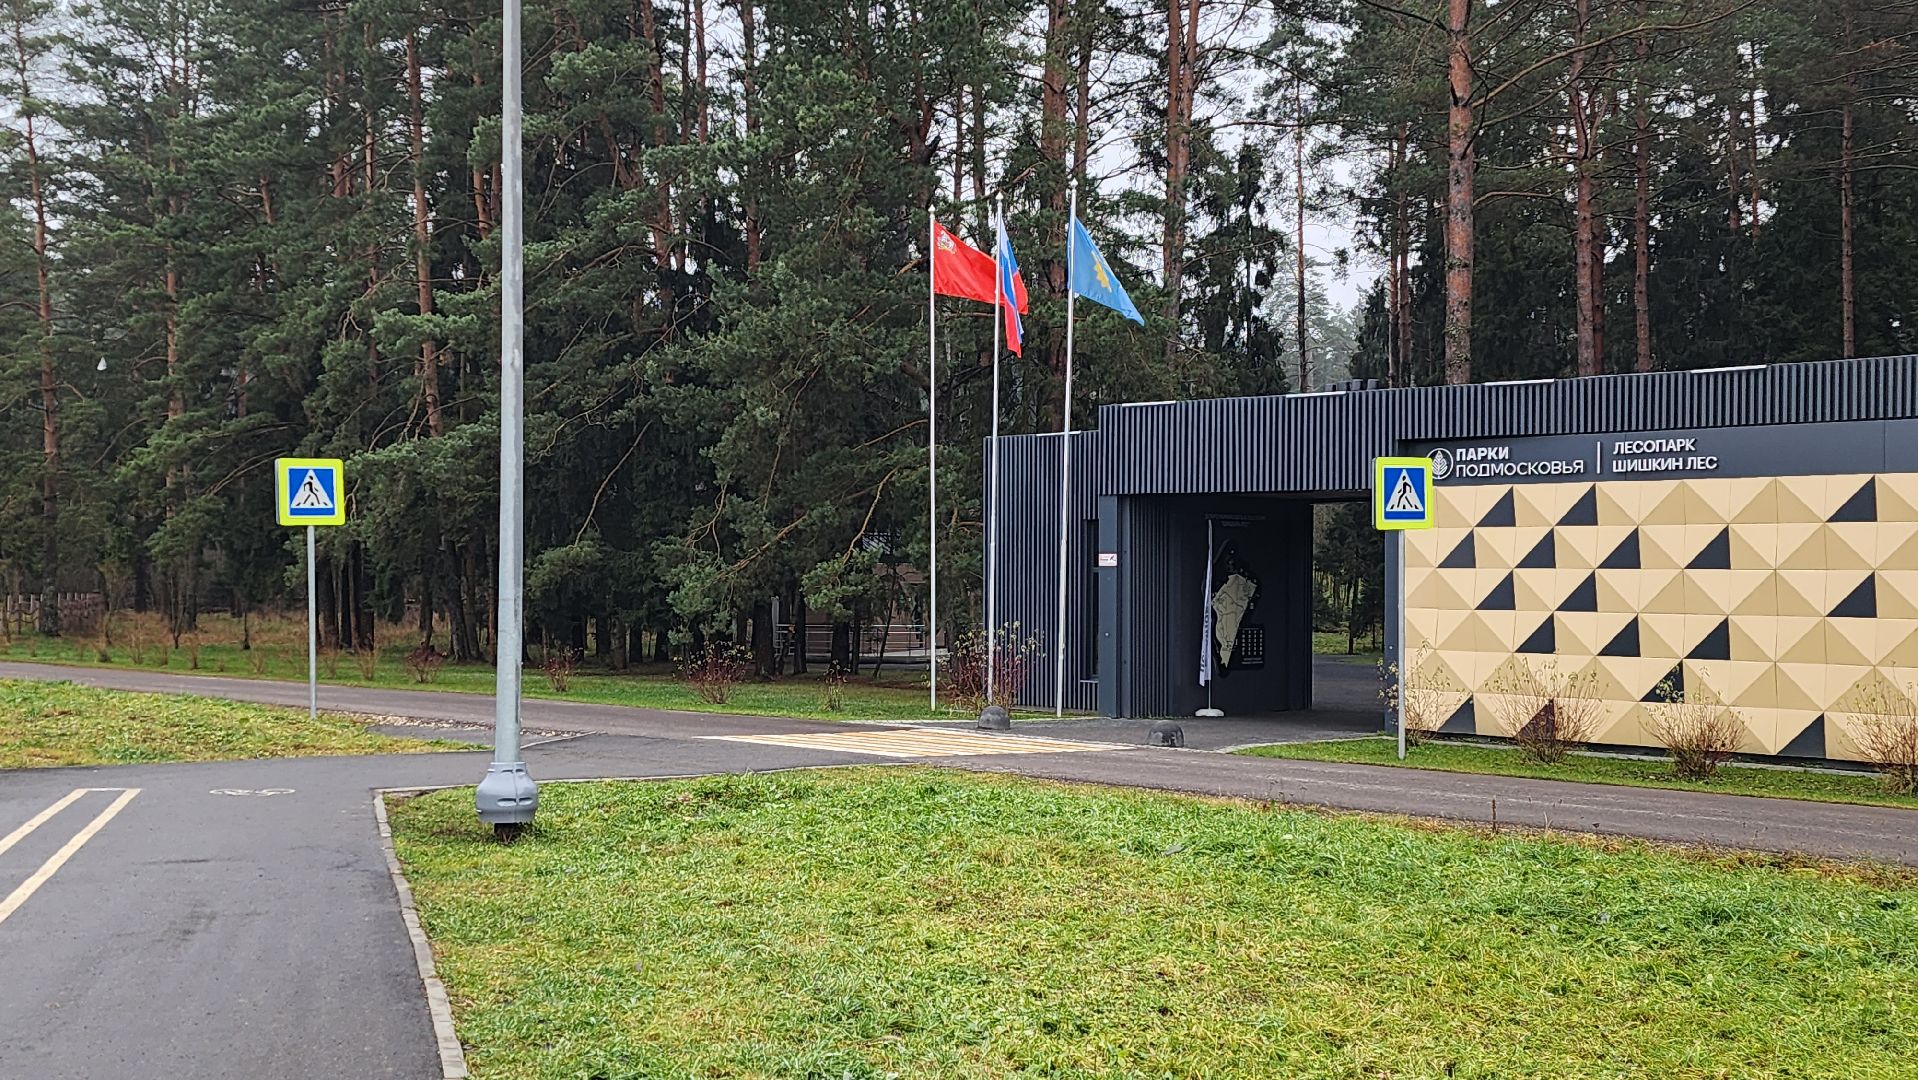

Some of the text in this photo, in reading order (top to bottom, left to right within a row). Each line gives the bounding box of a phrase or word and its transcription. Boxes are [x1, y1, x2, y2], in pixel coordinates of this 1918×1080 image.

[1456, 446, 1509, 462] ПАРКИ
[1612, 438, 1697, 455] ЛЕСОПАРК
[1456, 460, 1585, 478] ПОДМОСКОВЬЯ
[1612, 456, 1718, 473] ШИШКИН ЛЕС
